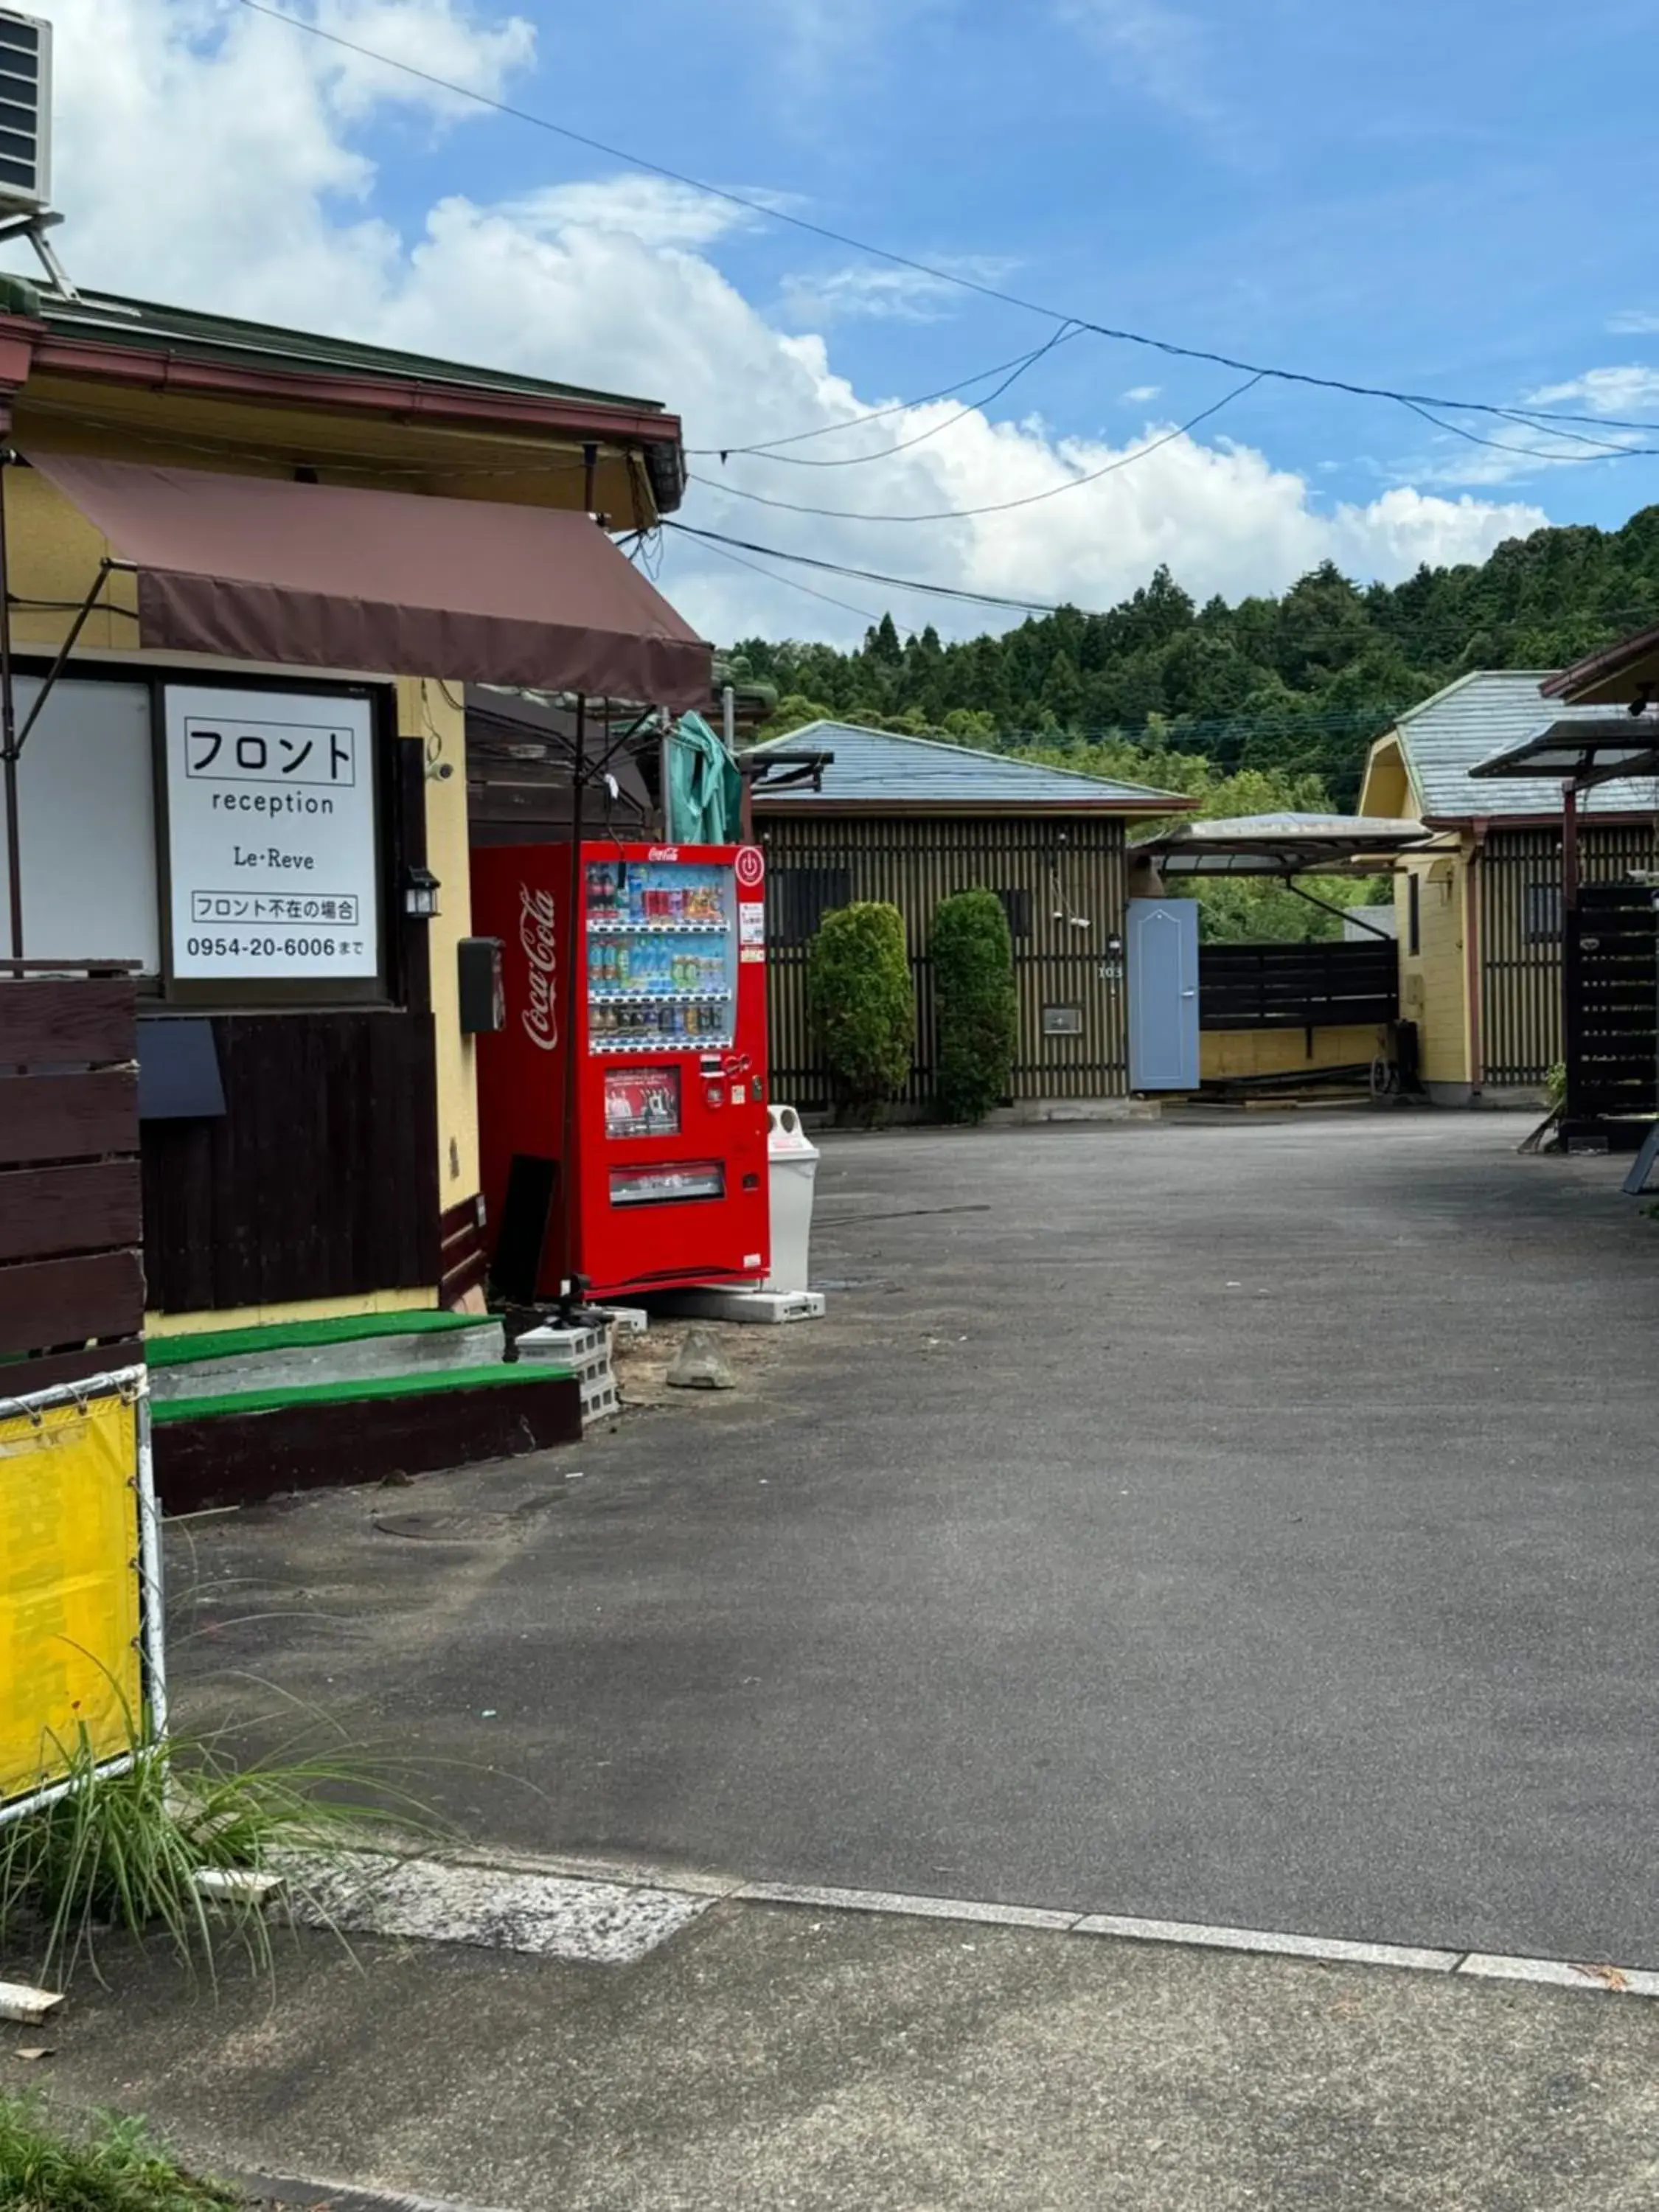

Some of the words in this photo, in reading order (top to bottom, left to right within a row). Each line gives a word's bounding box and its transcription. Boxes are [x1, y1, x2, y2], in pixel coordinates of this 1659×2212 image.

[190, 732, 349, 779] フロント
[212, 791, 333, 817] reception
[197, 899, 353, 919] フロント不在の場合
